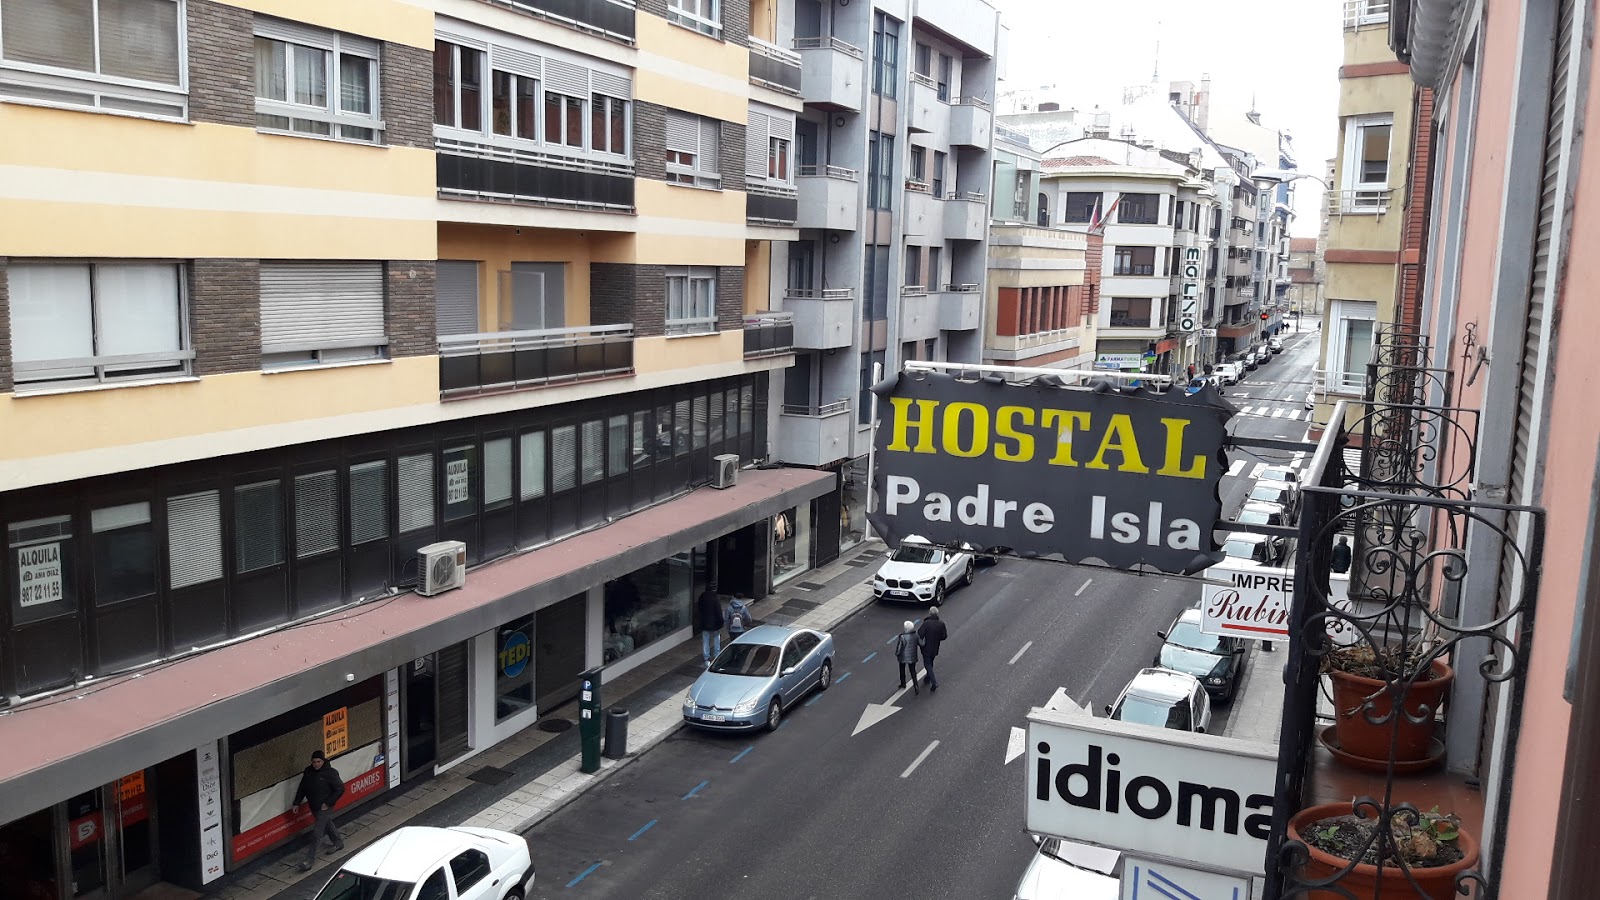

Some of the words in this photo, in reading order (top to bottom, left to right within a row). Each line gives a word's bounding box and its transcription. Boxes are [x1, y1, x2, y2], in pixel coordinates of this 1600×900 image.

[886, 397, 1208, 480] HOSTAL
[886, 474, 1055, 534] Padre
[1089, 495, 1201, 551] Isla
[21, 547, 58, 567] ALQUILA
[35, 571, 46, 580] ANA
[21, 585, 33, 603] 987
[34, 584, 43, 601] 22
[43, 582, 51, 599] 11
[52, 580, 60, 597] 55
[585, 680, 591, 690] P
[326, 711, 344, 726] ALQUILA
[351, 771, 380, 793] GRANDES
[1036, 741, 1273, 841] idioma
